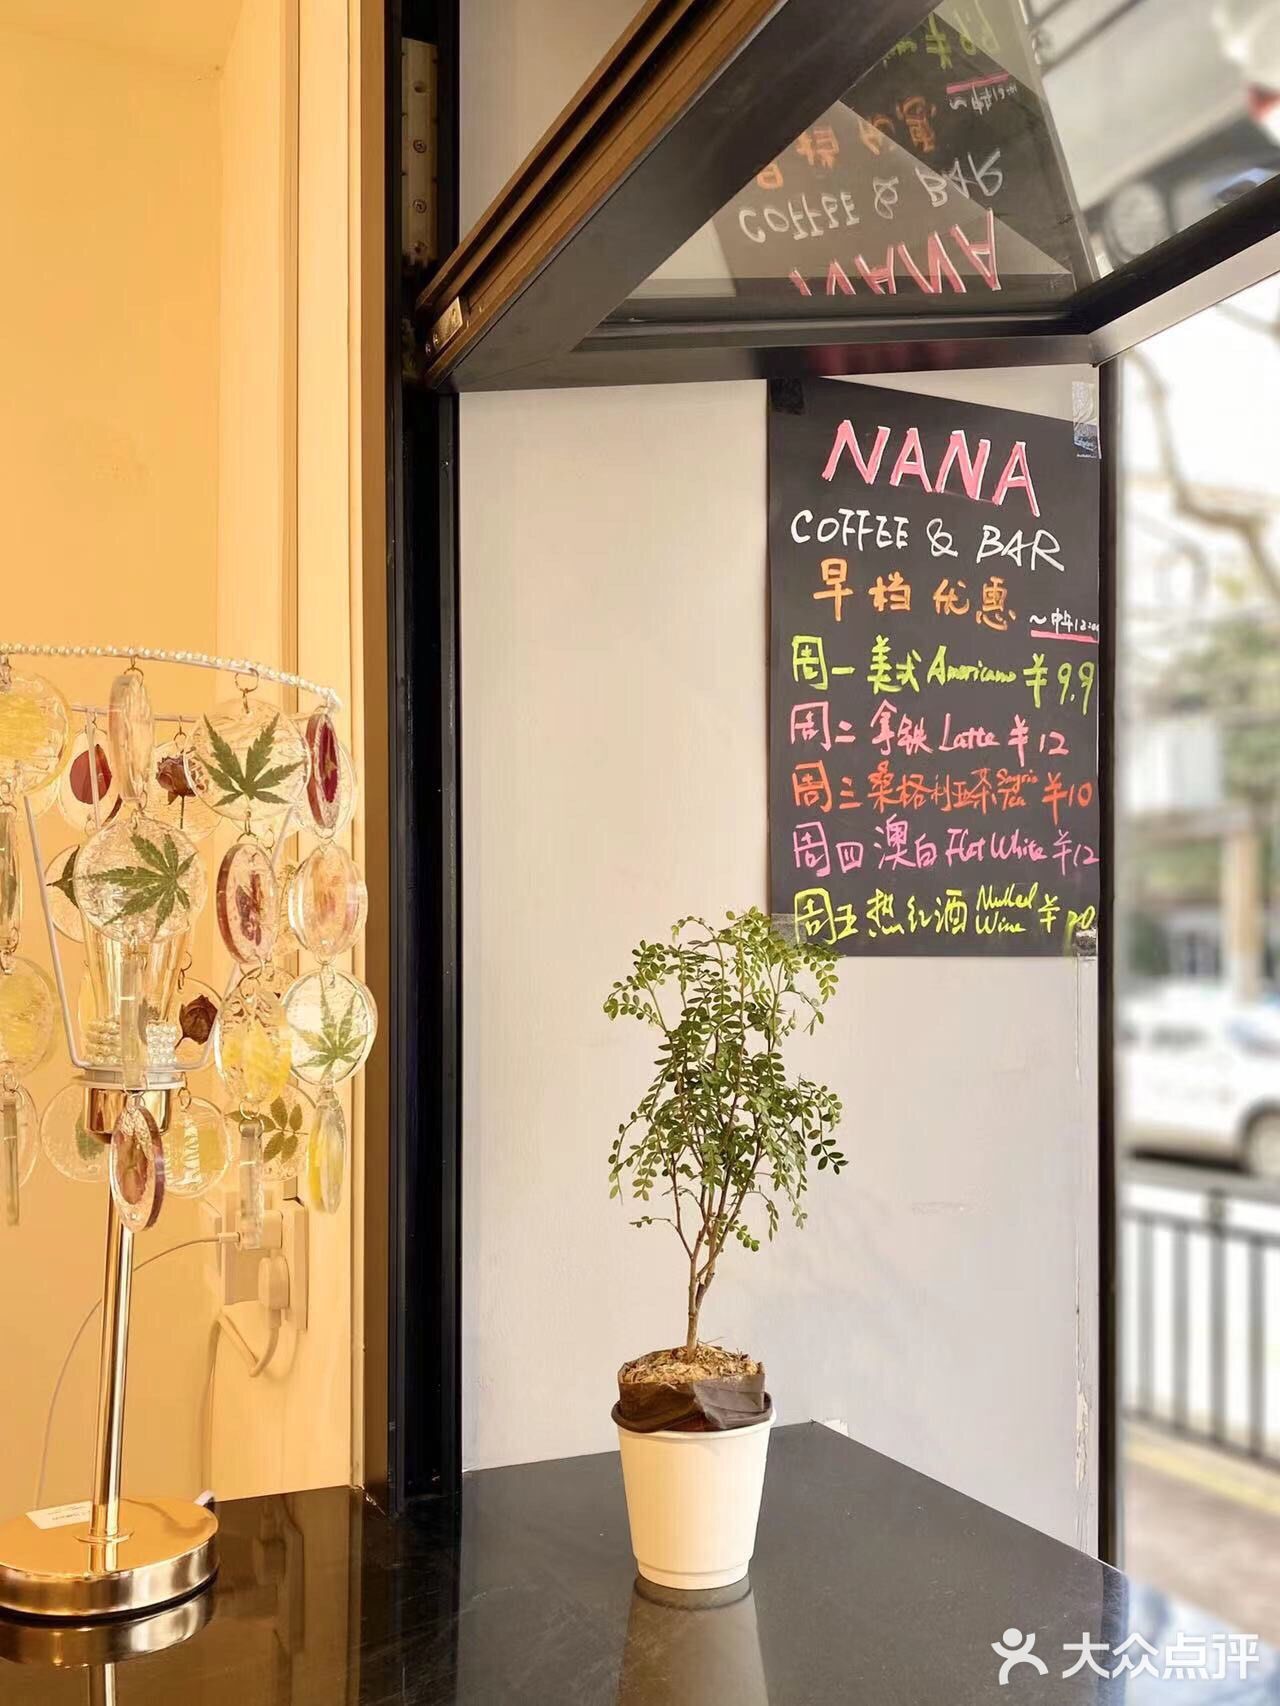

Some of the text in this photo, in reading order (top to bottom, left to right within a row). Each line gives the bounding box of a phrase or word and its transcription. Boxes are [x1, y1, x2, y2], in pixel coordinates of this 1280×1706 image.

[822, 419, 1041, 518] NANA
[790, 508, 1065, 572] COFFEE & BAR
[813, 557, 1017, 631] 早档优惠
[938, 713, 1000, 751] Latte
[945, 827, 985, 867] Flat
[990, 828, 1048, 860] White
[975, 909, 1027, 935] Wine
